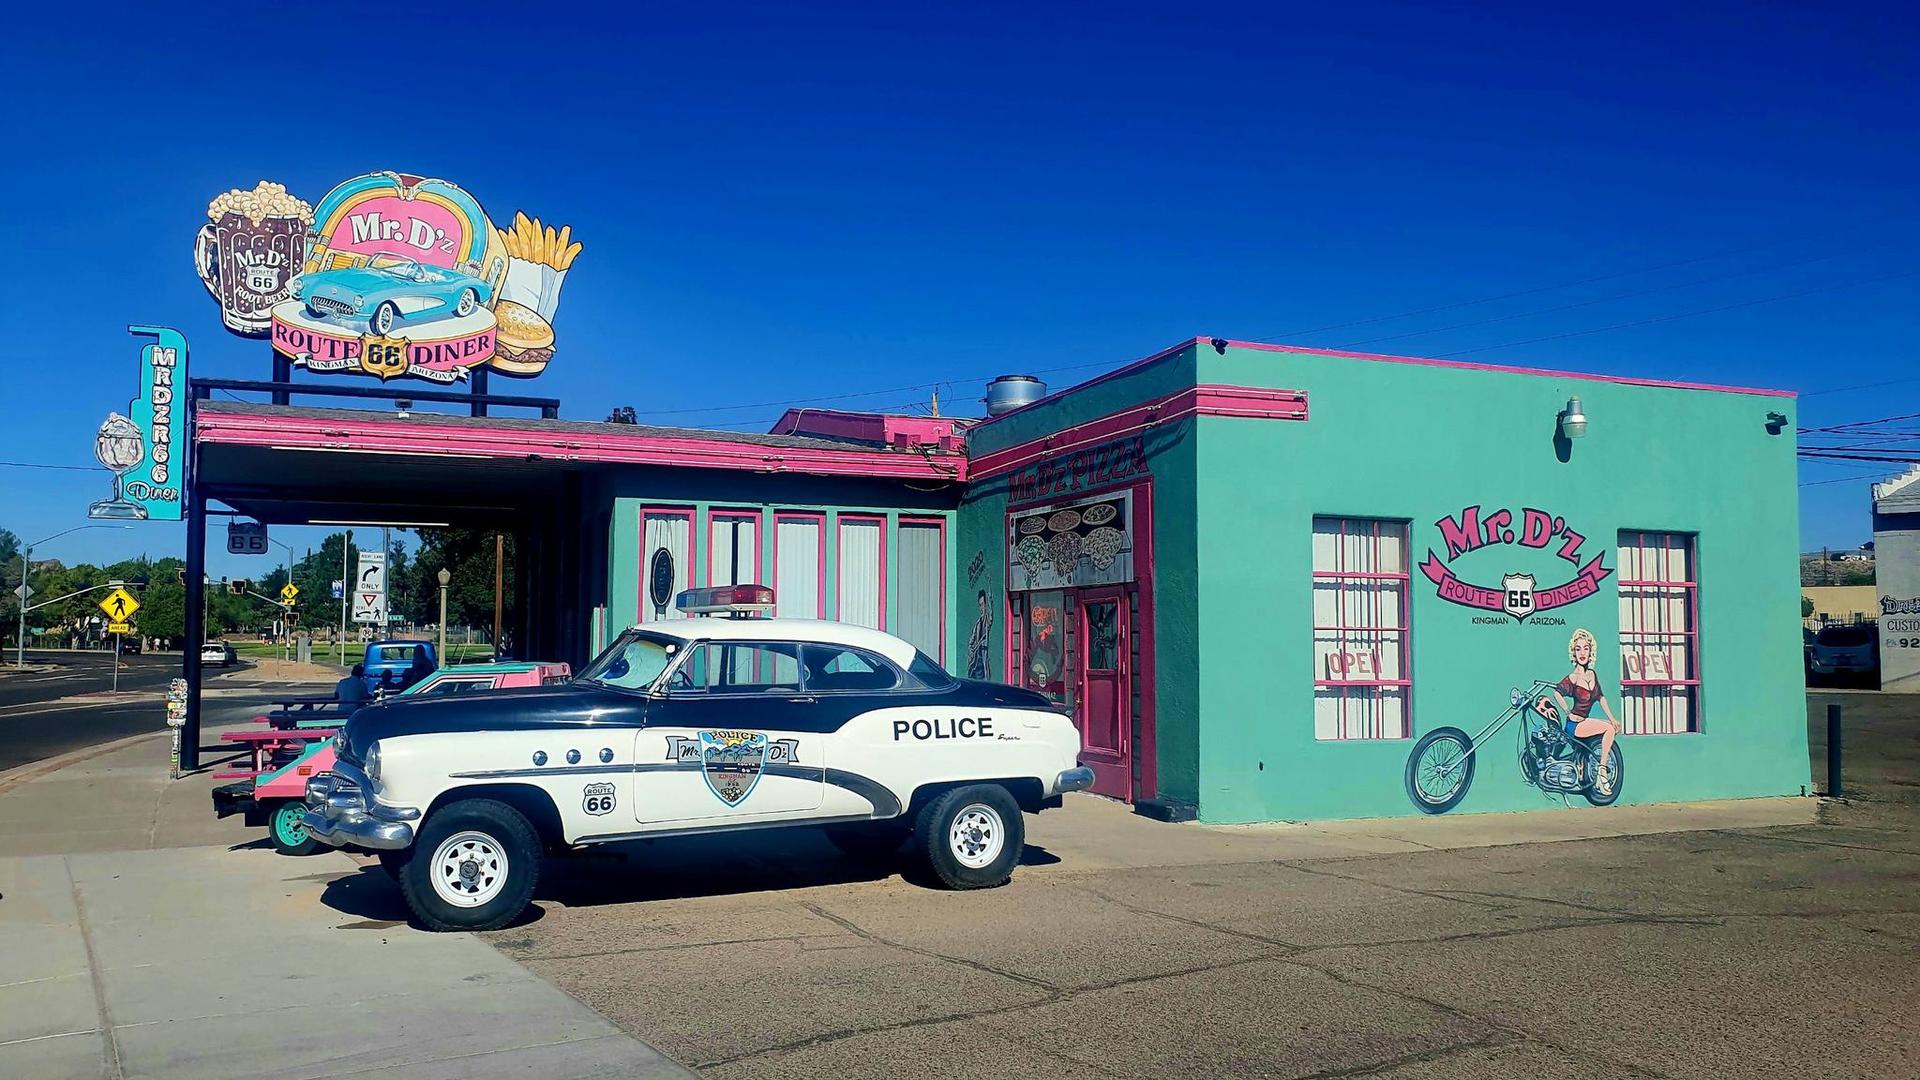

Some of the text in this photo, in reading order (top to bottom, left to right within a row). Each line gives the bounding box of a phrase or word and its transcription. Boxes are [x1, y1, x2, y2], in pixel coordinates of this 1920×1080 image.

[348, 211, 456, 255] Mr. D'z
[235, 249, 266, 268] Mr.
[253, 276, 273, 288] 66
[235, 285, 290, 304] ROOT BEER
[275, 322, 490, 366] ROUTE 66 DINER
[308, 359, 457, 381] KINGMAN ARIZONA
[1067, 437, 1150, 490] PIZZA
[126, 480, 179, 502] Diner
[231, 535, 263, 549] 66
[1435, 505, 1586, 568] Mr. D'z
[361, 582, 380, 590] ONLY
[1445, 579, 1592, 608] ROUTE 66 DINER
[1471, 616, 1566, 626] KINGMAN ARIZONA
[710, 731, 759, 743] POLICE
[893, 717, 994, 741] POLICE
[587, 796, 612, 812] 66
